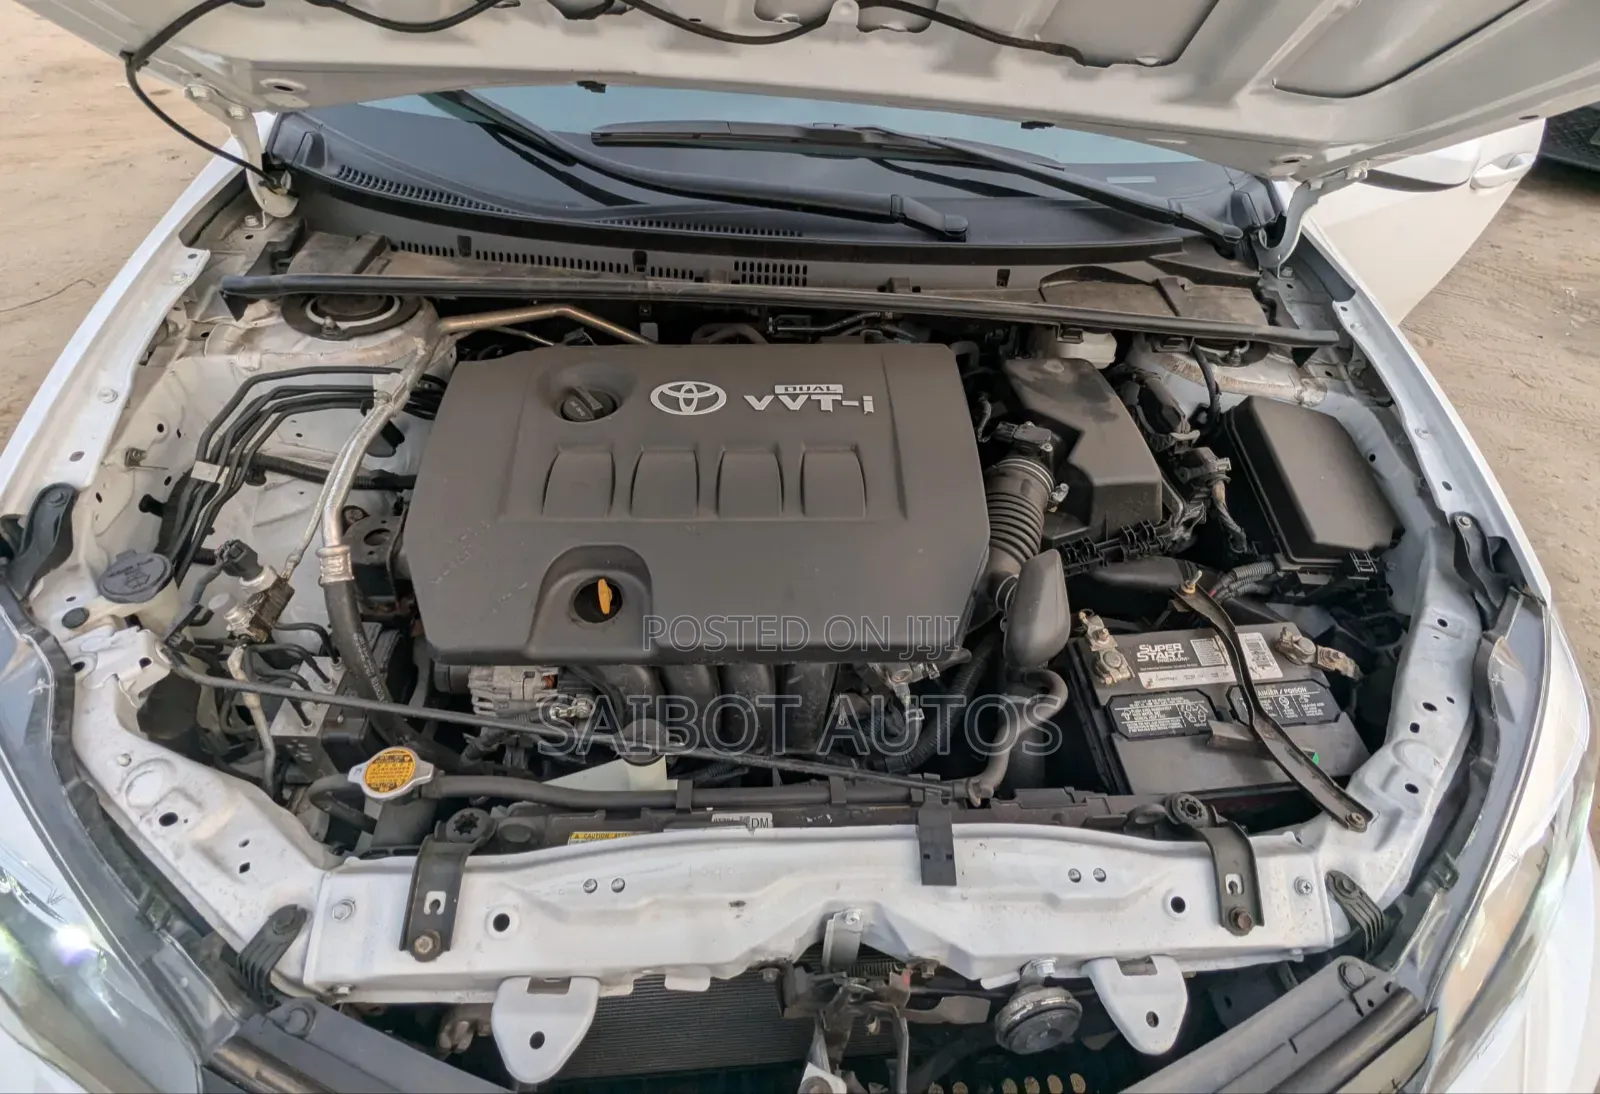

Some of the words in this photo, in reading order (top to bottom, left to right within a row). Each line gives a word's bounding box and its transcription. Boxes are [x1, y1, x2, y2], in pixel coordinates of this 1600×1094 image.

[1138, 643, 1182, 653] SUPER
[1136, 649, 1185, 662] START
[1257, 689, 1279, 697] ANGER
[1283, 686, 1308, 694] POISON
[751, 817, 769, 828] DM
